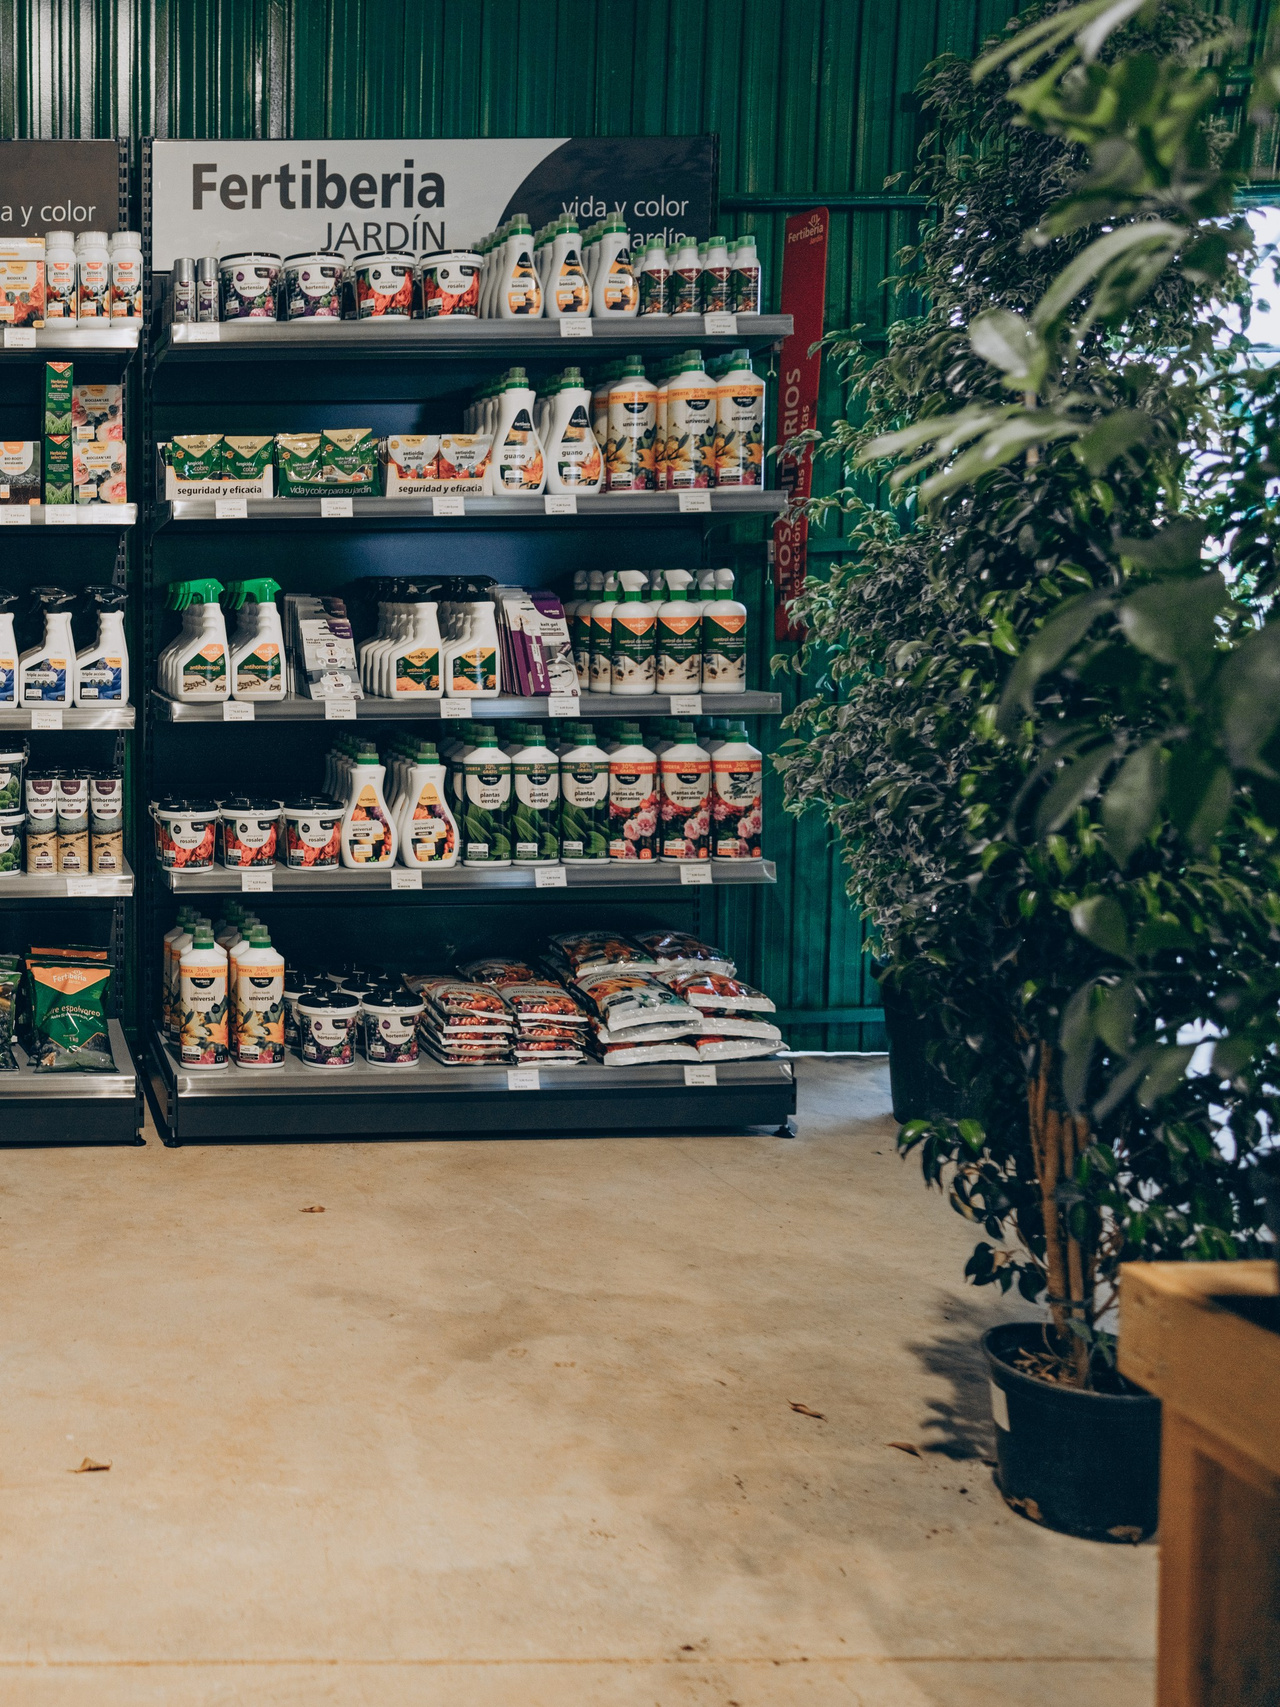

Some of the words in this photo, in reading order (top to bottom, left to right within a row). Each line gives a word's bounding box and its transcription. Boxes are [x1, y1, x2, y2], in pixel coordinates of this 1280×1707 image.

[192, 159, 445, 210] Fertiberia
[20, 205, 33, 228] y
[40, 199, 96, 222] color
[562, 195, 607, 217] vida
[614, 201, 626, 212] y
[633, 194, 690, 217] color
[320, 213, 446, 252] JARDÍN
[787, 223, 824, 244] Fertiberia
[290, 486, 304, 494] vida
[310, 486, 327, 494] color
[328, 488, 342, 496] para
[353, 485, 372, 496] jardín
[398, 484, 442, 494] seguridad
[450, 484, 482, 492] eficacia
[795, 469, 805, 491] las
[178, 486, 220, 496] seguridad
[222, 487, 228, 496] y
[230, 486, 262, 494] eficacia
[52, 972, 86, 983] Fertiberia
